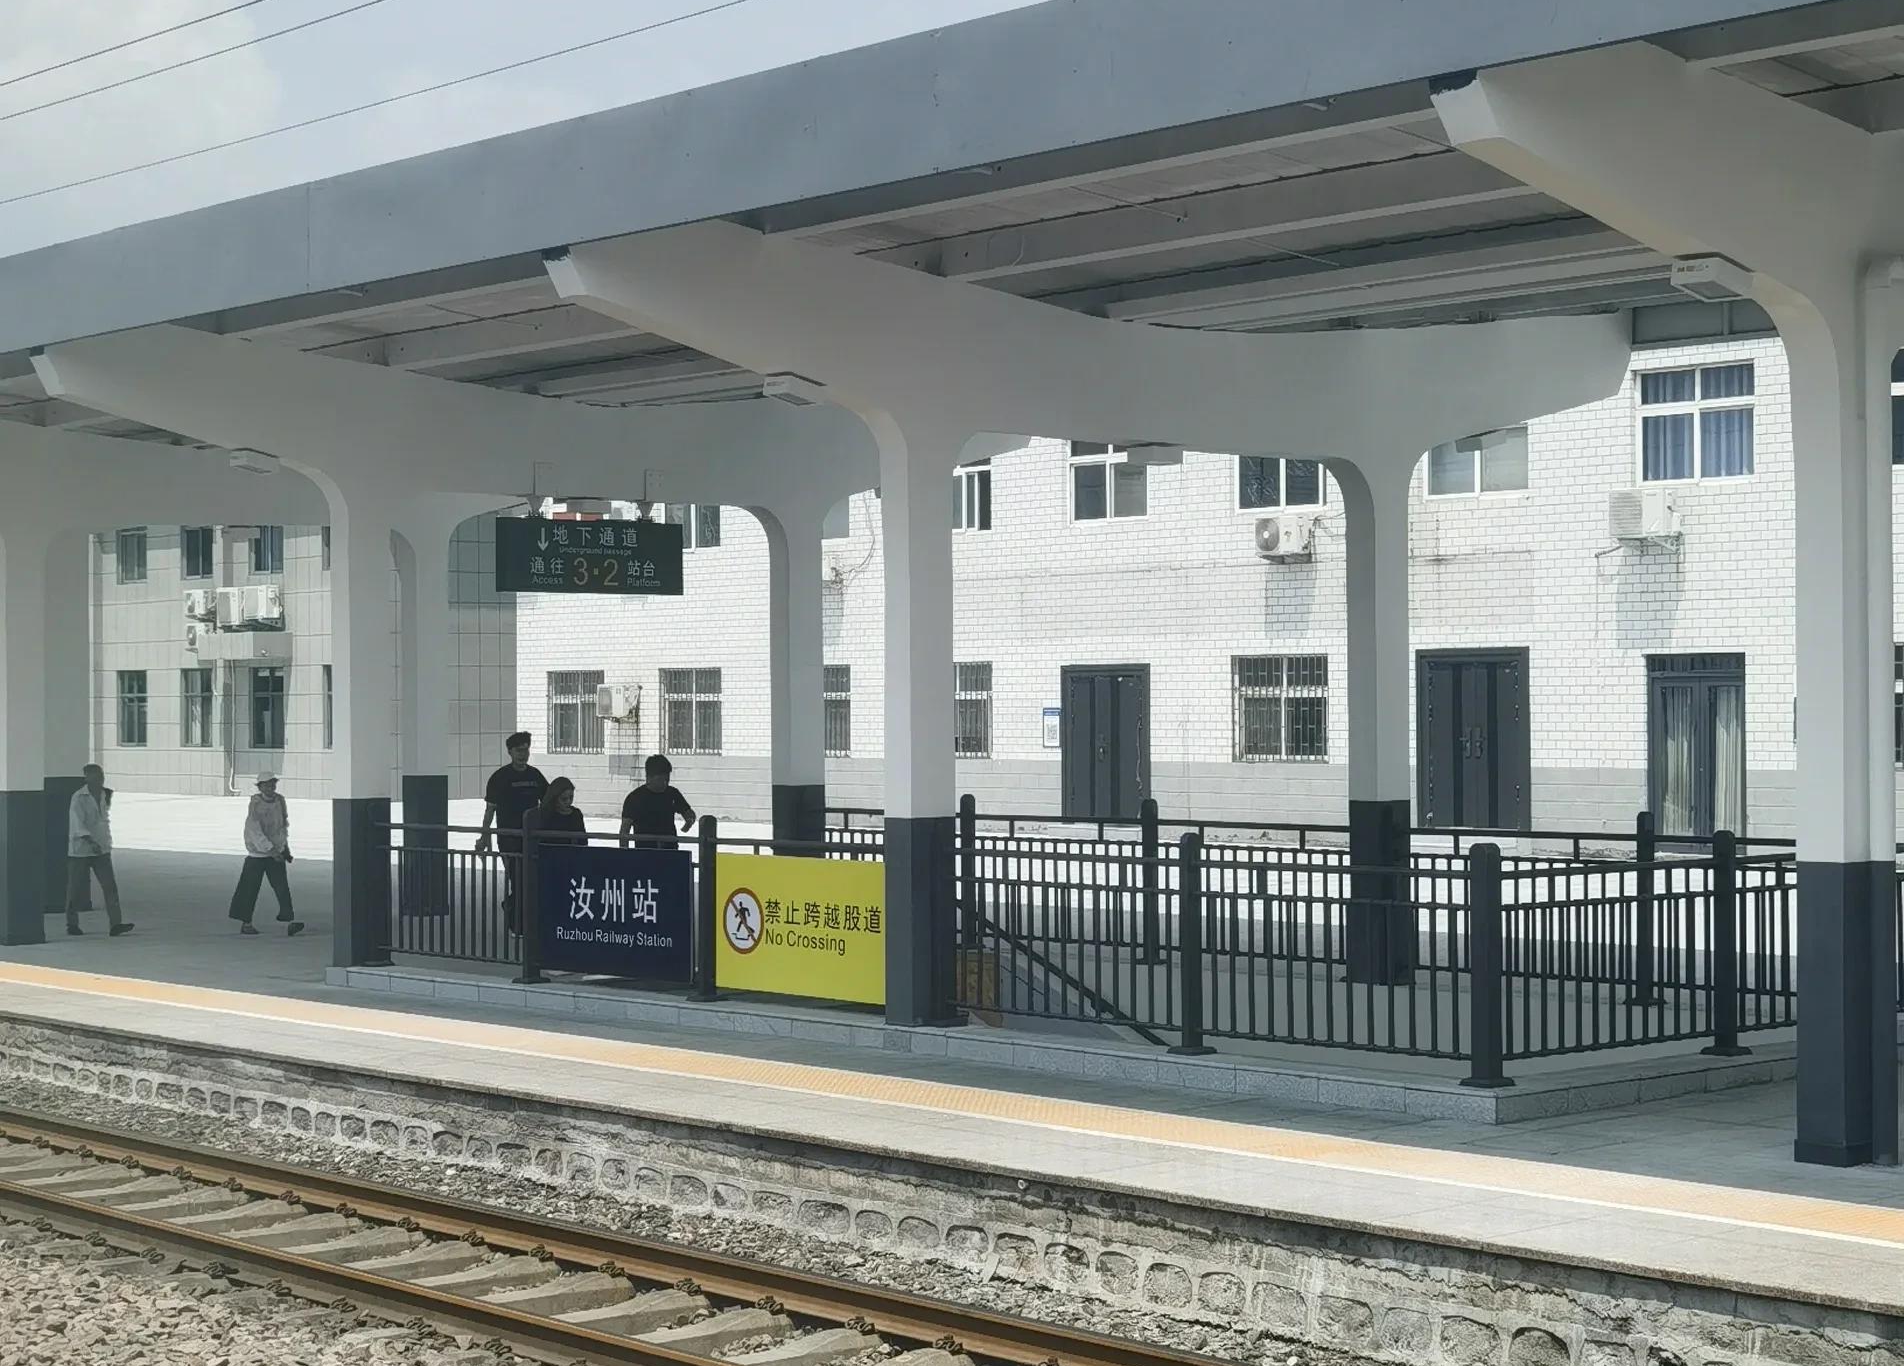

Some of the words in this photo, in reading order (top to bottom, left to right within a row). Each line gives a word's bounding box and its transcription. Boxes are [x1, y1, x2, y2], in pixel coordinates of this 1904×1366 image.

[553, 525, 638, 547] 地下通道
[530, 556, 565, 575] 通往
[627, 559, 656, 577] 站台
[531, 575, 564, 585] Access
[627, 577, 661, 587] Platform
[569, 876, 659, 924] 汝州站
[765, 898, 882, 934] 禁止跨越股道
[556, 926, 593, 941] Ruzhou
[595, 929, 635, 948] Railway
[636, 931, 673, 948] Station
[765, 928, 783, 946] No
[786, 930, 846, 956] Crossing
